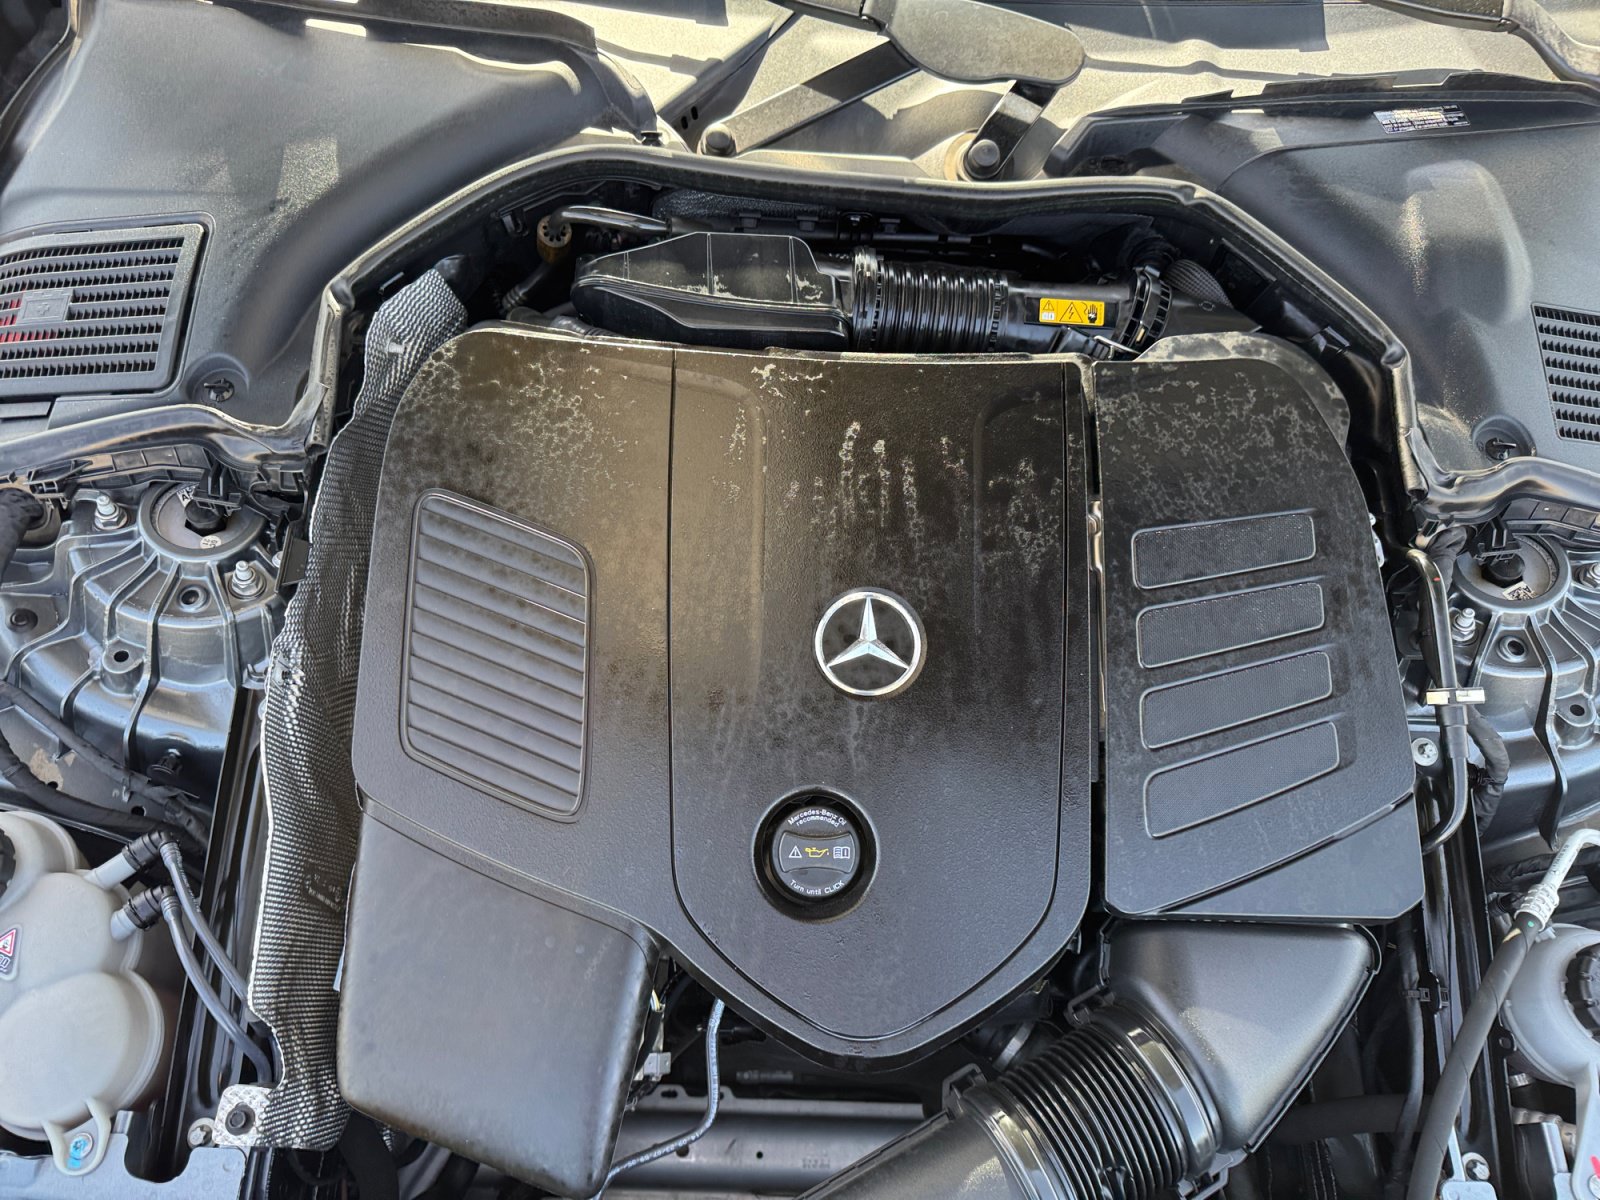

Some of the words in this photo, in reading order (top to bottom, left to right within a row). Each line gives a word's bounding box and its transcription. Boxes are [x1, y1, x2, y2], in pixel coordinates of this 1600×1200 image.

[788, 809, 838, 825] Mercedes-Benz
[838, 817, 847, 826] Oil
[796, 815, 839, 828] recommended
[790, 879, 805, 892] Turn
[824, 880, 845, 894] CLICK
